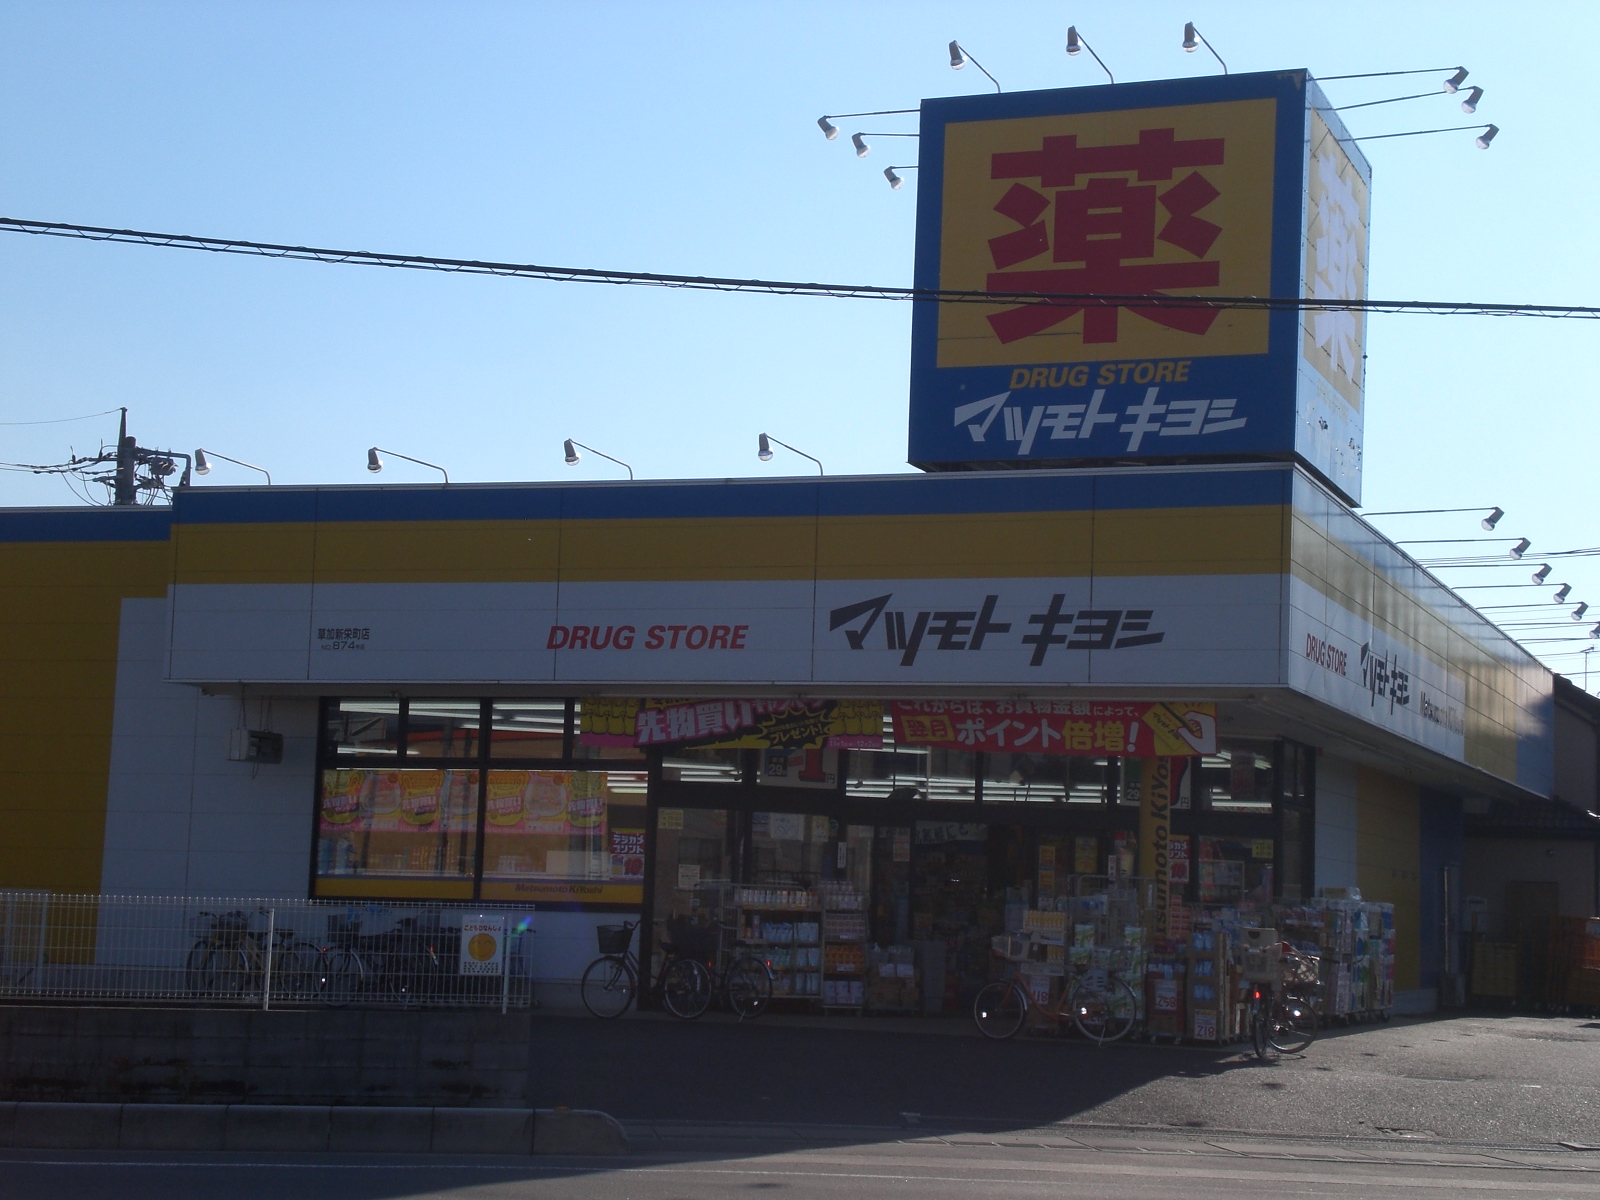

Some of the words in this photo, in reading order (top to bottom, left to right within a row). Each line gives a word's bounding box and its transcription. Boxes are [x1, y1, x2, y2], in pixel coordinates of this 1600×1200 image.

[985, 127, 1225, 345] 薬
[1009, 364, 1090, 391] DRUG
[1098, 360, 1192, 386] STORE
[953, 386, 1248, 456] マツモトキヨシ
[546, 625, 636, 650] DRUG
[644, 625, 749, 650] STORE
[829, 593, 1166, 667] マツモトキヨシ
[1306, 632, 1326, 667] DRUG
[1326, 644, 1348, 677] STORE
[637, 701, 752, 744] 先物買い
